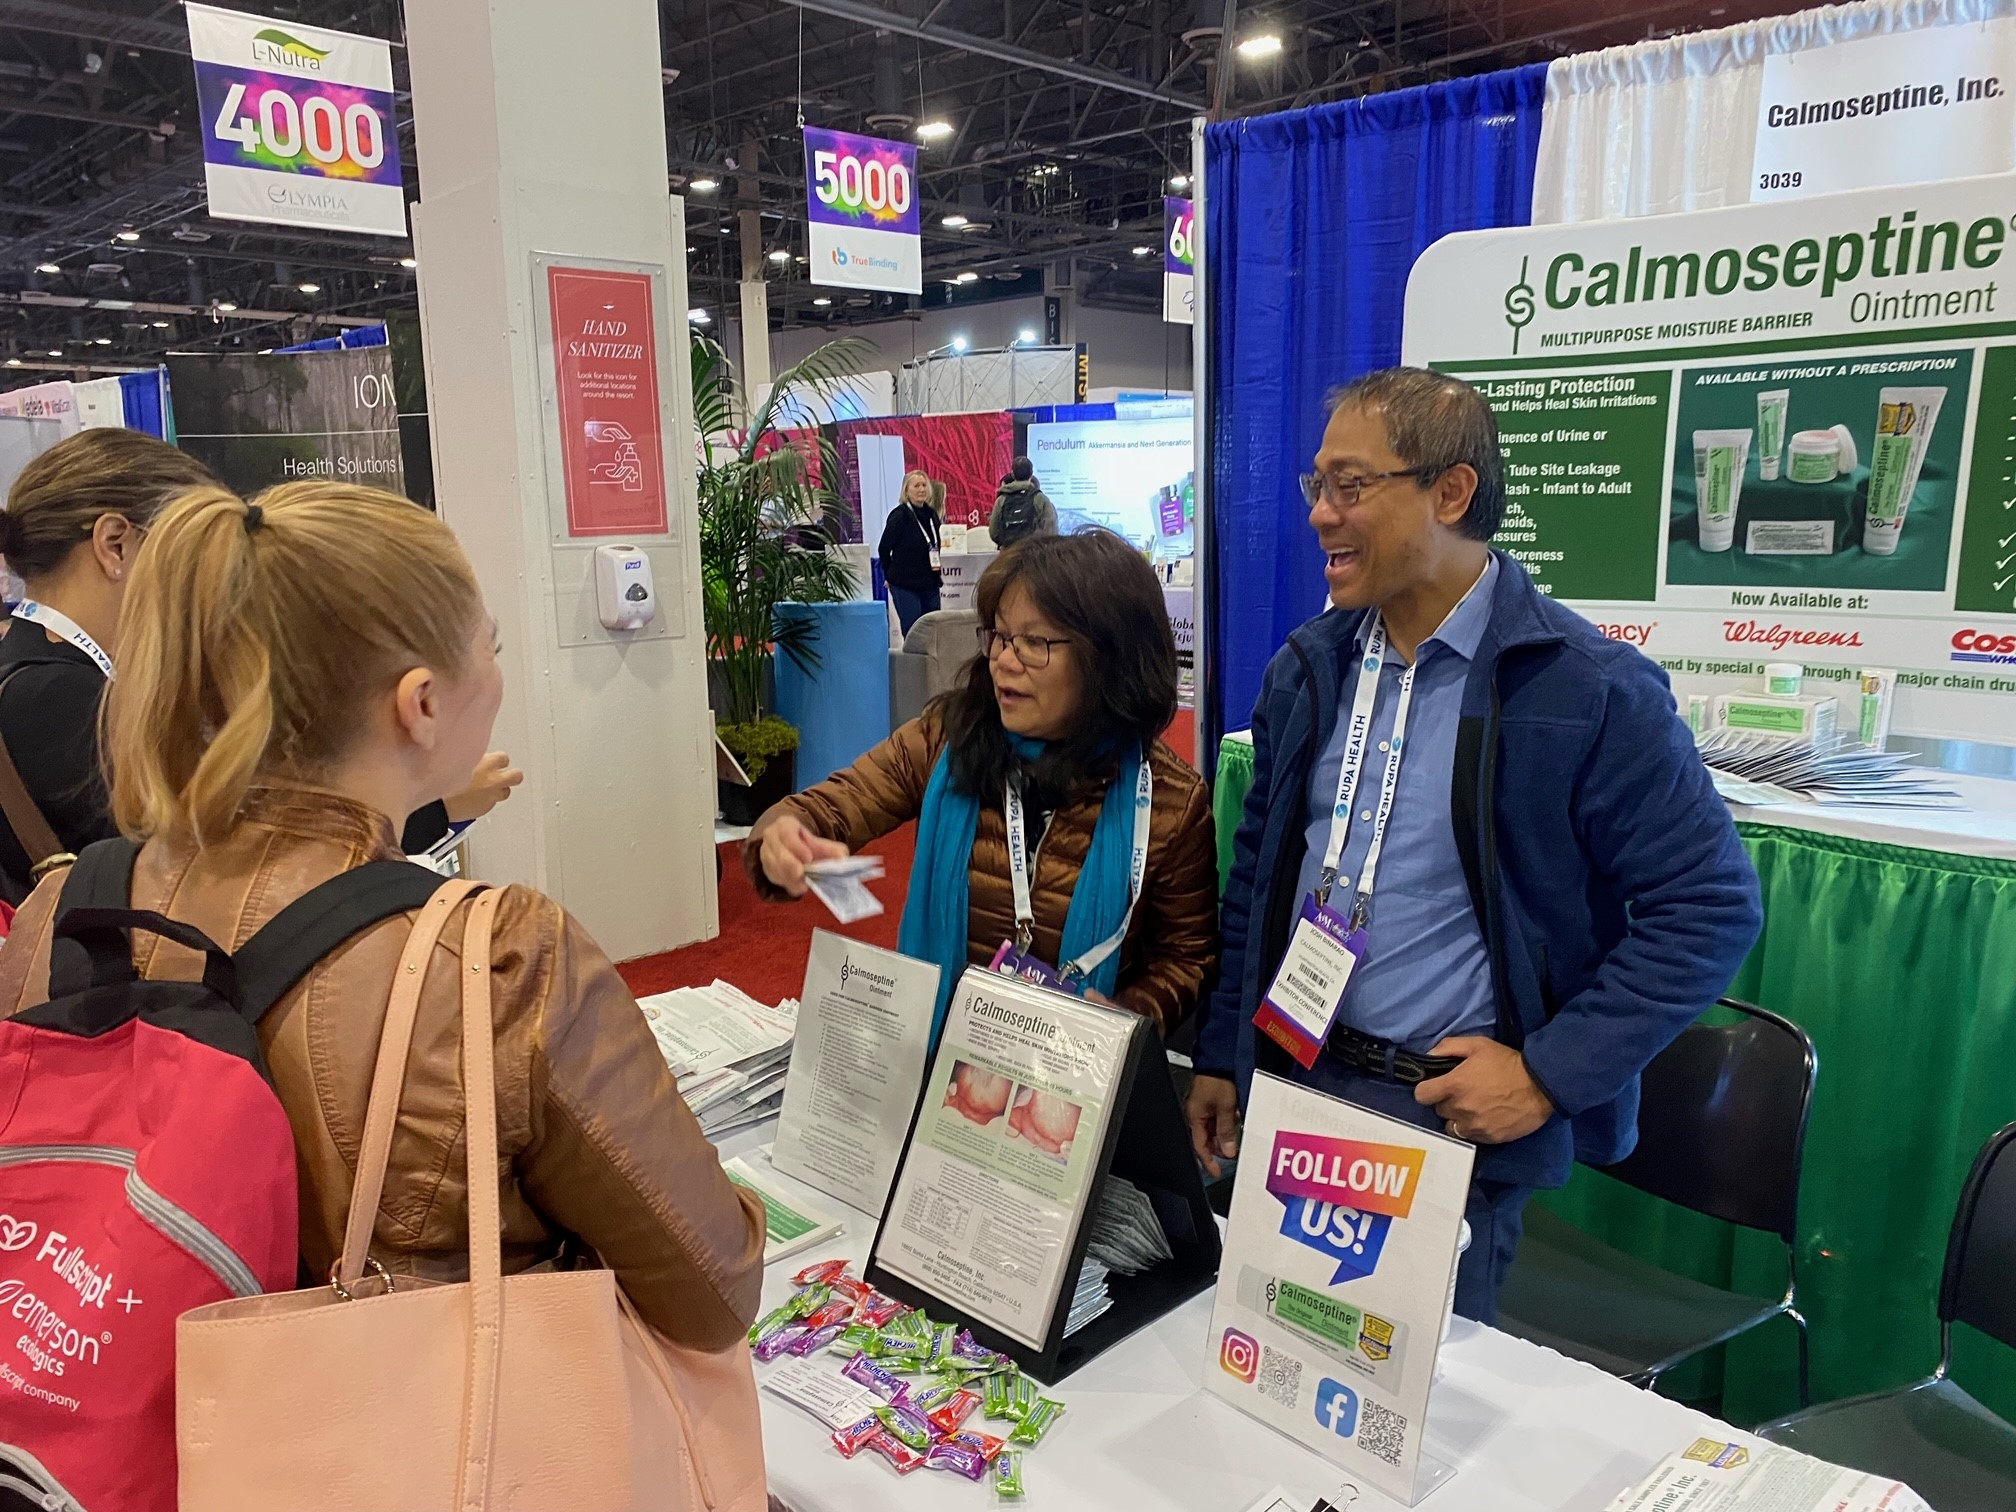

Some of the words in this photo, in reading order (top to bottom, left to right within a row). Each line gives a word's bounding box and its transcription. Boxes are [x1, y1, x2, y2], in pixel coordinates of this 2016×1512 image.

[252, 43, 321, 71] L-Nutra
[1768, 84, 1950, 128] Calmoseptine,
[1956, 76, 2006, 100] Inc.
[214, 83, 384, 169] 4000
[814, 150, 911, 214] 5000
[1759, 171, 1803, 191] 3039
[851, 255, 899, 271] TrueBinding
[1849, 281, 1998, 324] Ointment
[581, 319, 628, 337] HAND
[1541, 324, 1653, 348] MULTIPURPOSE
[1657, 318, 1738, 339] MOISTURE
[1742, 311, 1814, 334] BARRIER
[567, 340, 643, 360] SANITIZER
[577, 371, 592, 380] Look
[593, 371, 603, 380] for
[603, 371, 614, 381] this
[615, 373, 628, 381] icon
[629, 372, 638, 382] for
[580, 381, 609, 390] additional
[610, 383, 637, 391] locations
[1550, 376, 1636, 396] Protection
[1695, 370, 1768, 386] AVAILABLE
[1771, 365, 1835, 381] WITHOUT
[1836, 366, 1848, 376] A
[1850, 357, 1958, 376] PRESCRIPTION
[582, 390, 604, 399] around
[605, 391, 616, 399] the
[1512, 399, 1543, 413] Helps
[1545, 397, 1569, 410] Heal
[1572, 396, 1598, 409] Skin
[1600, 394, 1658, 408] Irritations
[1037, 438, 1086, 451] Pendulum
[1088, 440, 1126, 450] Akkermansia
[1127, 440, 1139, 449] and
[1140, 439, 1155, 448] Next
[1156, 438, 1192, 448] Generation
[1498, 431, 1538, 443] inence
[1540, 429, 1554, 442] of
[1556, 429, 1590, 442] Urine
[1593, 430, 1608, 441] or
[283, 457, 334, 476] Health
[337, 455, 396, 475] Solutions
[1509, 464, 1538, 477] Tube
[1540, 462, 1565, 476] Site
[1567, 462, 1621, 476] Leakage
[1542, 482, 1579, 495] Infant
[1582, 483, 1595, 495] to
[1597, 481, 1632, 495] Adult
[1508, 549, 1564, 561] Soreness
[1731, 591, 1767, 606] Now
[1769, 592, 1842, 609] Available
[1847, 595, 1869, 610] at:
[1371, 623, 1384, 655] RUPA
[1723, 620, 1864, 652] Walgreens
[73, 632, 111, 671] EALTH
[1660, 660, 1683, 673] and
[1686, 661, 1701, 676] by
[1705, 663, 1751, 677] special
[1802, 666, 1851, 684] hrough
[1896, 672, 1939, 690] major
[1942, 674, 1985, 691] chain
[1347, 715, 1366, 765] HEALTH
[1341, 767, 1357, 801] RUPA
[1385, 755, 1399, 788] RUPA
[1011, 826, 1023, 873] HEALTH
[869, 984, 892, 999] Ointment
[968, 1020, 992, 1033] PROTECTS
[991, 1028, 1003, 1036] AND
[1003, 1032, 1018, 1042] HELPS
[1019, 1037, 1031, 1047] HEAL
[1031, 1042, 1043, 1051] SKIN
[1275, 1147, 1410, 1198] FOLLOW
[1299, 1197, 1373, 1256] US!
[36, 1231, 113, 1309] Fullscript
[16, 1334, 65, 1377] ecologics
[0, 1363, 25, 1391] llscript
[23, 1384, 81, 1412] company
[1675, 1474, 1698, 1494] Inc.
